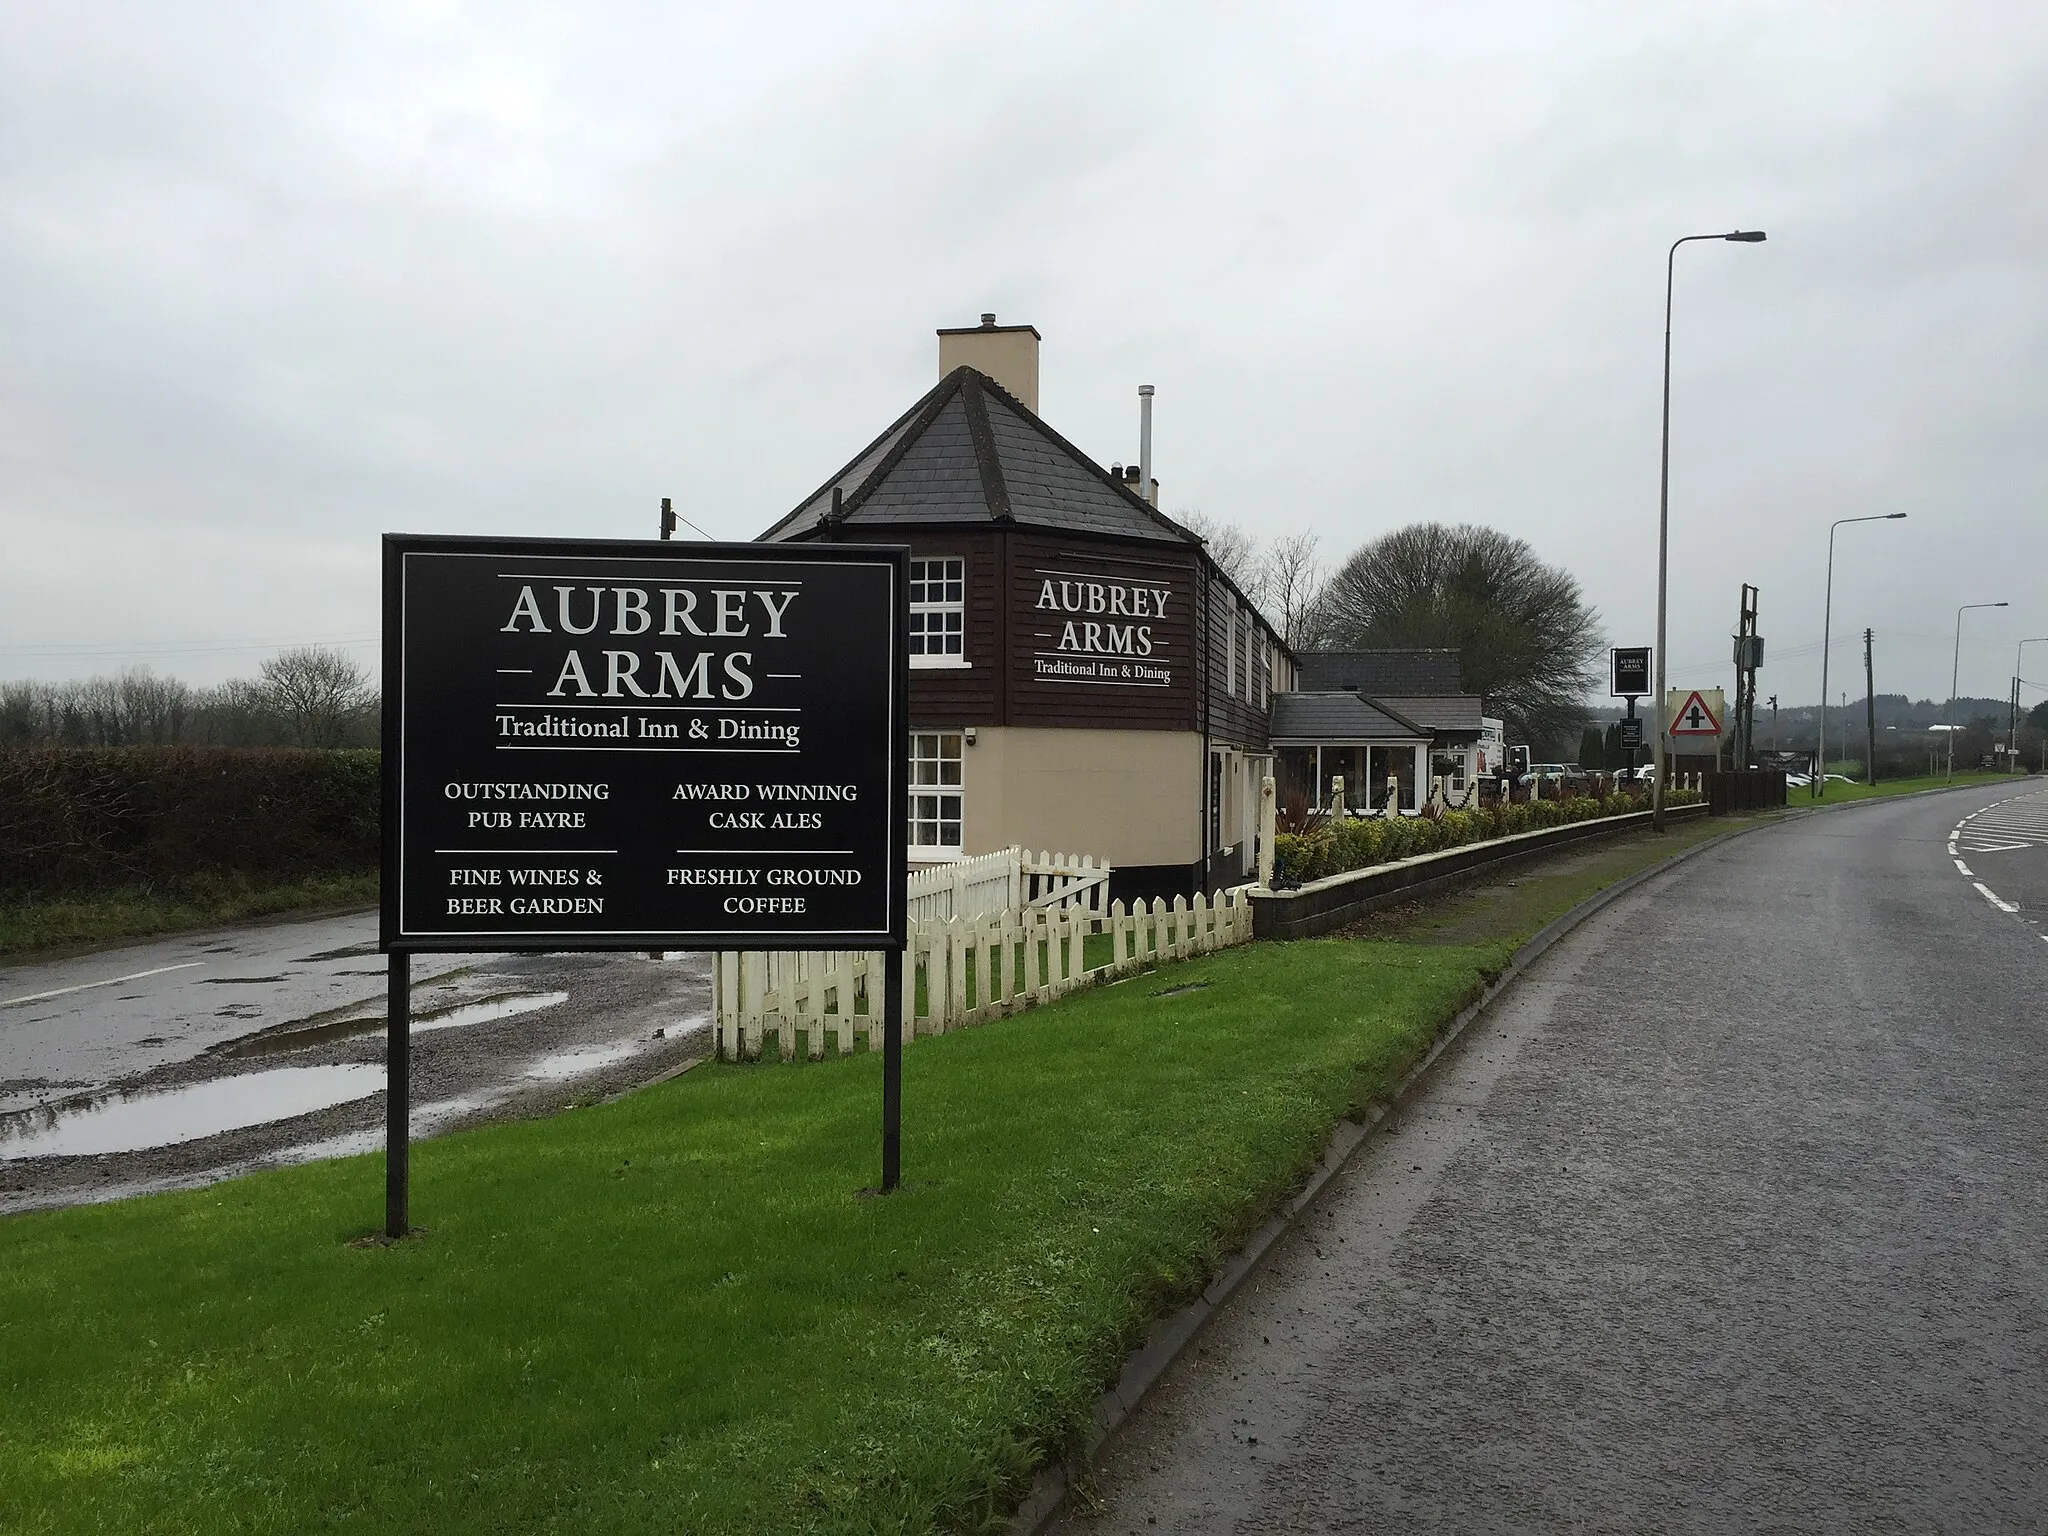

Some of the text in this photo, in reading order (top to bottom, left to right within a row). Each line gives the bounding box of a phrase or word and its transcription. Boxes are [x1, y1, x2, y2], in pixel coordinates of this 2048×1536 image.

[1035, 579, 1172, 619] AUBREY
[499, 585, 799, 638] AUBREY
[1056, 621, 1152, 657] ARMS
[546, 649, 754, 701] ARMS
[1034, 659, 1171, 683] Traditional Inn & Dining
[495, 715, 801, 747] Traditional Inn & Dining
[444, 782, 610, 801] OUTSTANDING
[672, 783, 858, 802] AWARD WINNING
[467, 811, 586, 828] PUB FAYRE
[709, 812, 822, 829] CASK ALES
[449, 869, 603, 886] FINE WINES &
[666, 868, 862, 886] FRESHLY GROUND
[446, 898, 605, 915] BEER GARDEN
[723, 897, 807, 914] COFFEE
